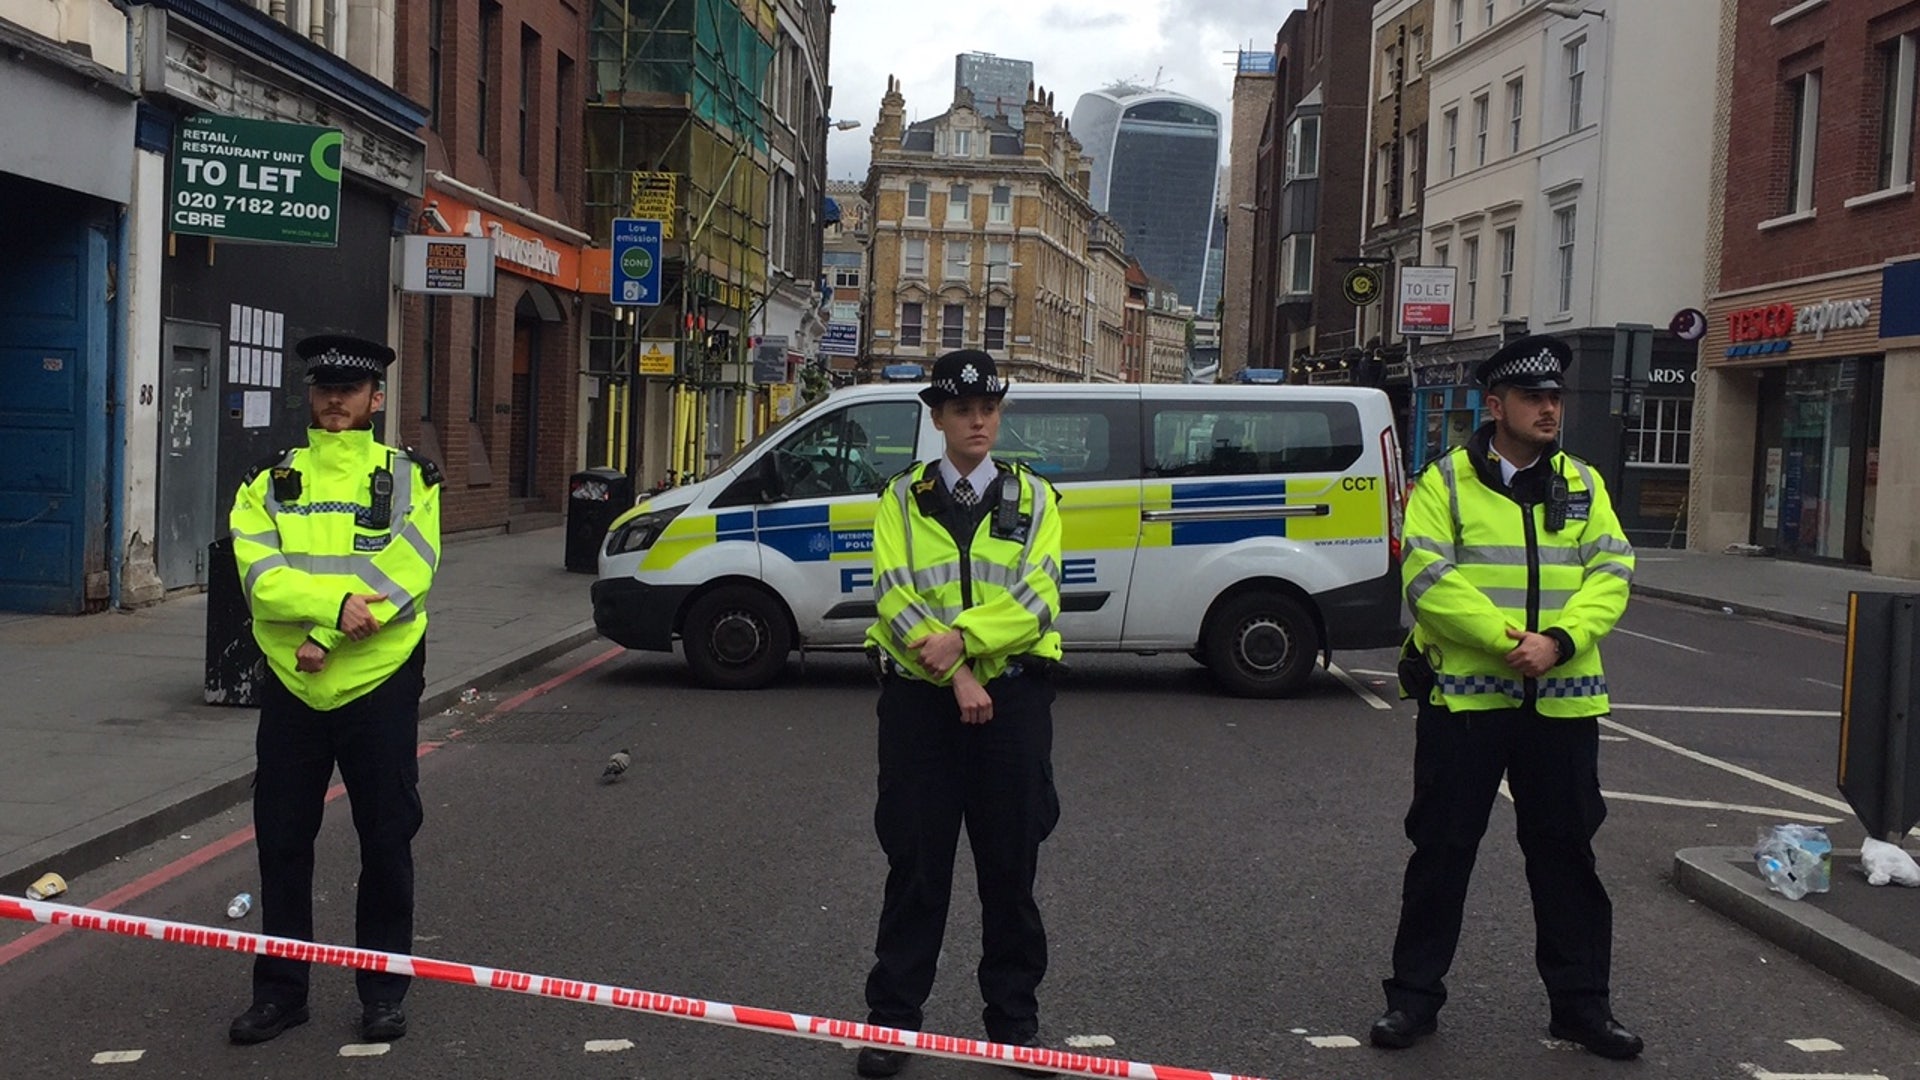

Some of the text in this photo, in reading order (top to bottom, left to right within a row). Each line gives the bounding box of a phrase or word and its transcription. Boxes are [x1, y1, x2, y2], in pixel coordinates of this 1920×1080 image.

[183, 129, 238, 144] RETAIL /
[182, 142, 304, 164] RESTAURANT UNIT
[181, 157, 302, 194] TO LET
[177, 191, 330, 220] 020 7182 2000
[175, 210, 226, 228] CBRE
[628, 223, 648, 232] Low
[616, 234, 658, 243] emission
[429, 244, 465, 257] MERGE
[623, 258, 649, 267] ZONE
[1406, 284, 1450, 296] TO LET
[1726, 298, 1872, 343] TESCO express
[1342, 476, 1377, 491] CCT
[837, 532, 873, 540] METROPO
[1314, 538, 1383, 546] www.met.police.uk
